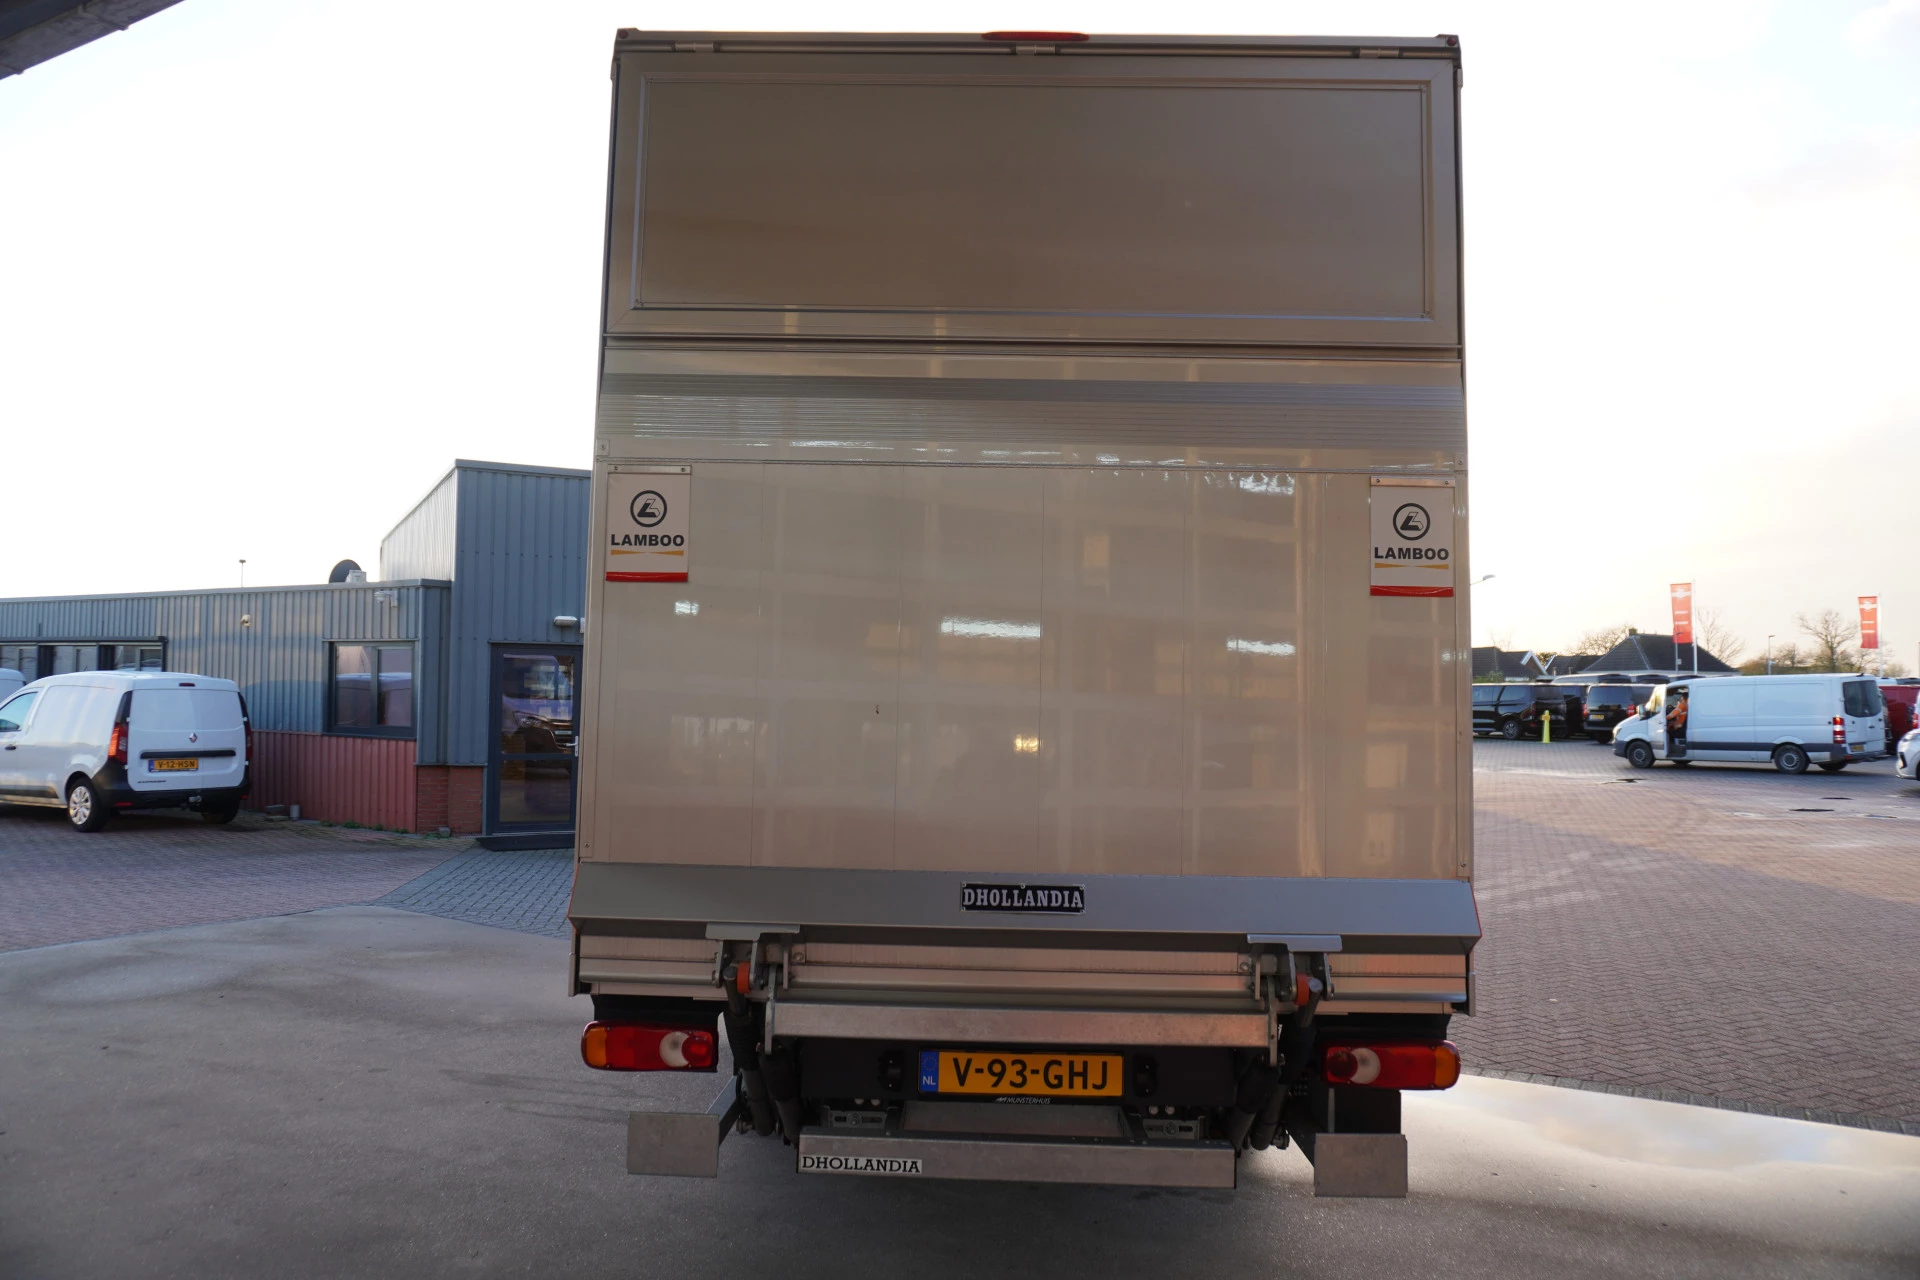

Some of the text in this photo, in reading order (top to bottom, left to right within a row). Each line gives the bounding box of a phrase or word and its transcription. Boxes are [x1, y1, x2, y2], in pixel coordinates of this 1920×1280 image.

[611, 534, 685, 547] LAMBOO
[1374, 547, 1449, 560] LAMBOO
[963, 888, 1083, 908] DHOLLANDIA
[922, 1075, 936, 1085] NL
[952, 1057, 1108, 1090] V-93-GHJ
[802, 1156, 921, 1174] DHOLLANDIA
